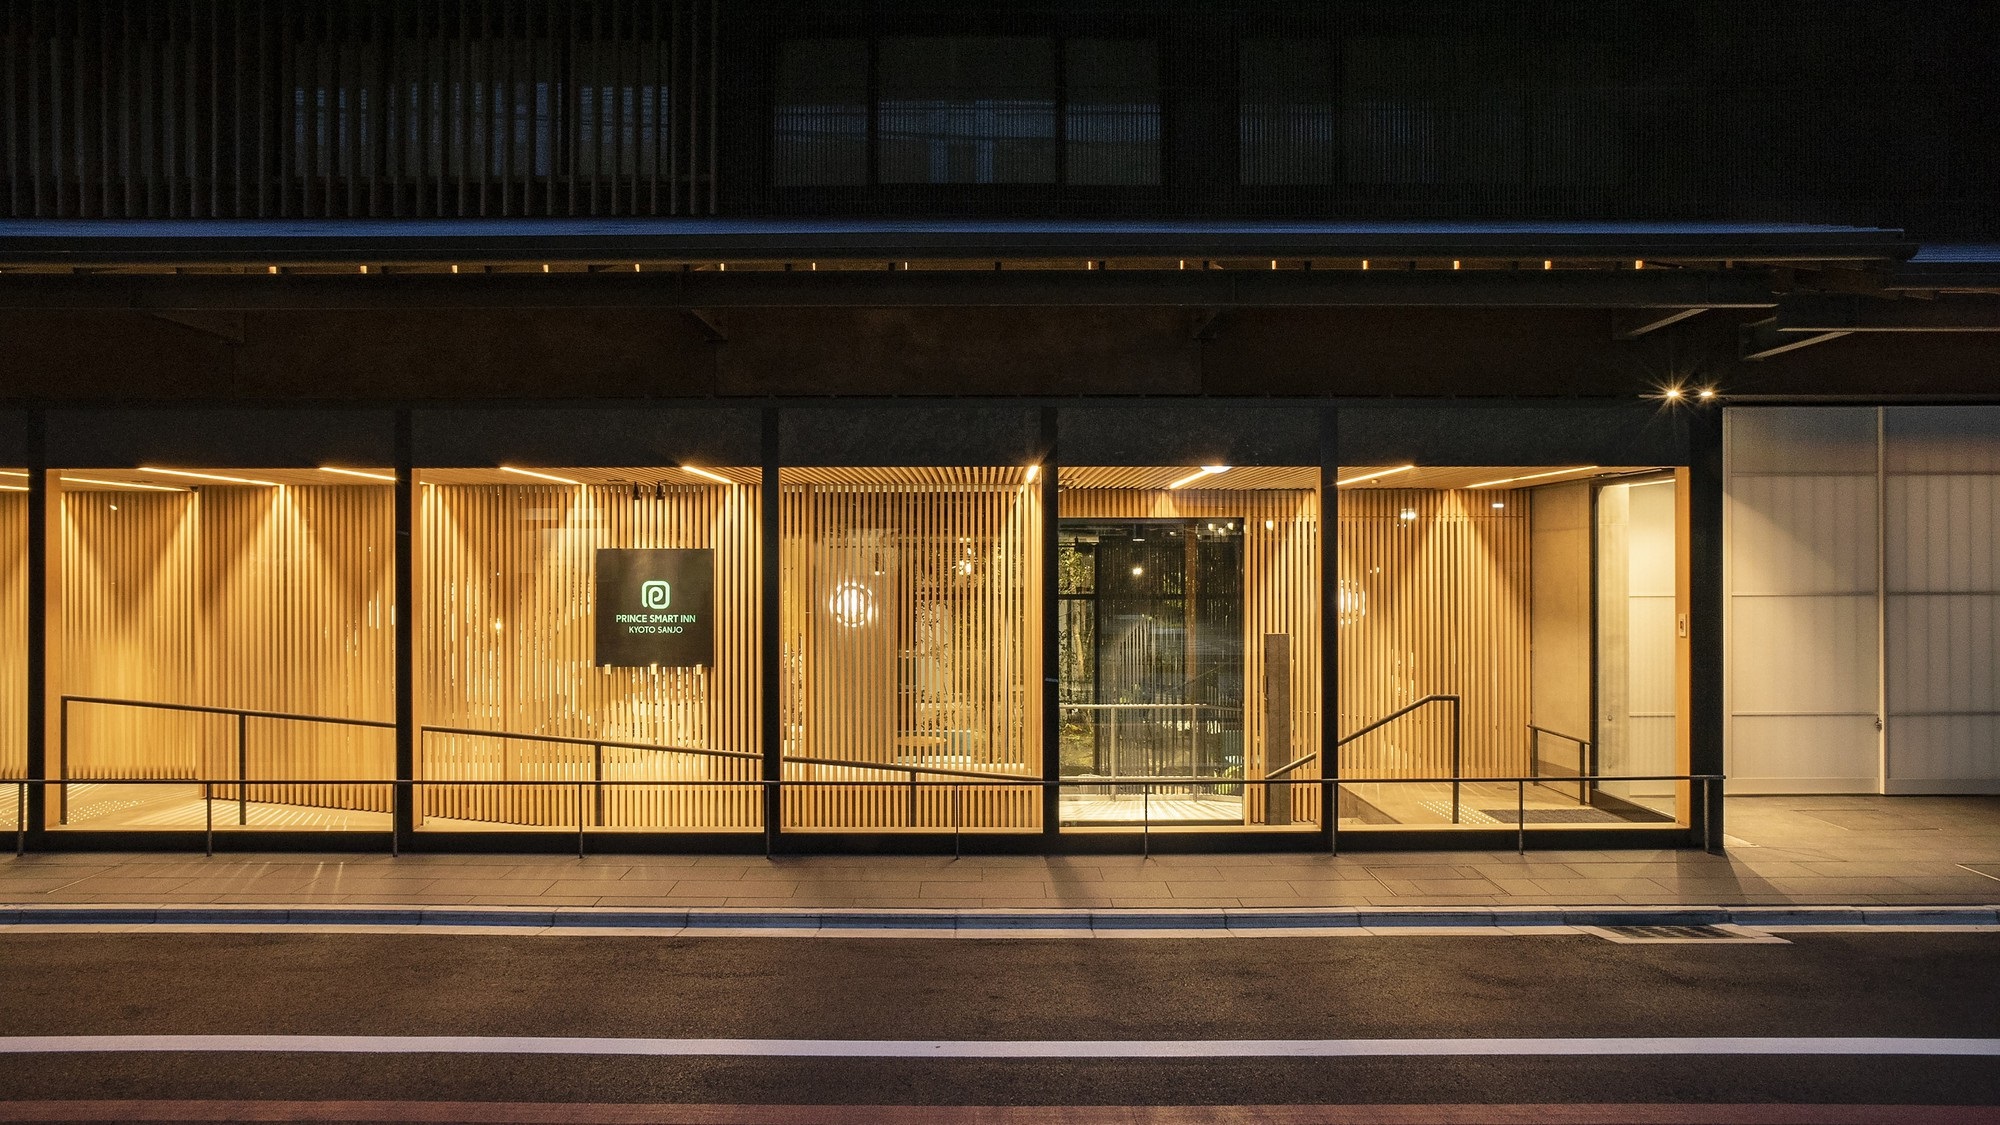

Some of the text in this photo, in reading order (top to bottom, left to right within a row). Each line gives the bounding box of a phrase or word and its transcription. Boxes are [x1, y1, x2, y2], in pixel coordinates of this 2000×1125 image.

[616, 614, 696, 623] PRINCE SMART INN
[628, 626, 683, 634] KYOTO SANJO
